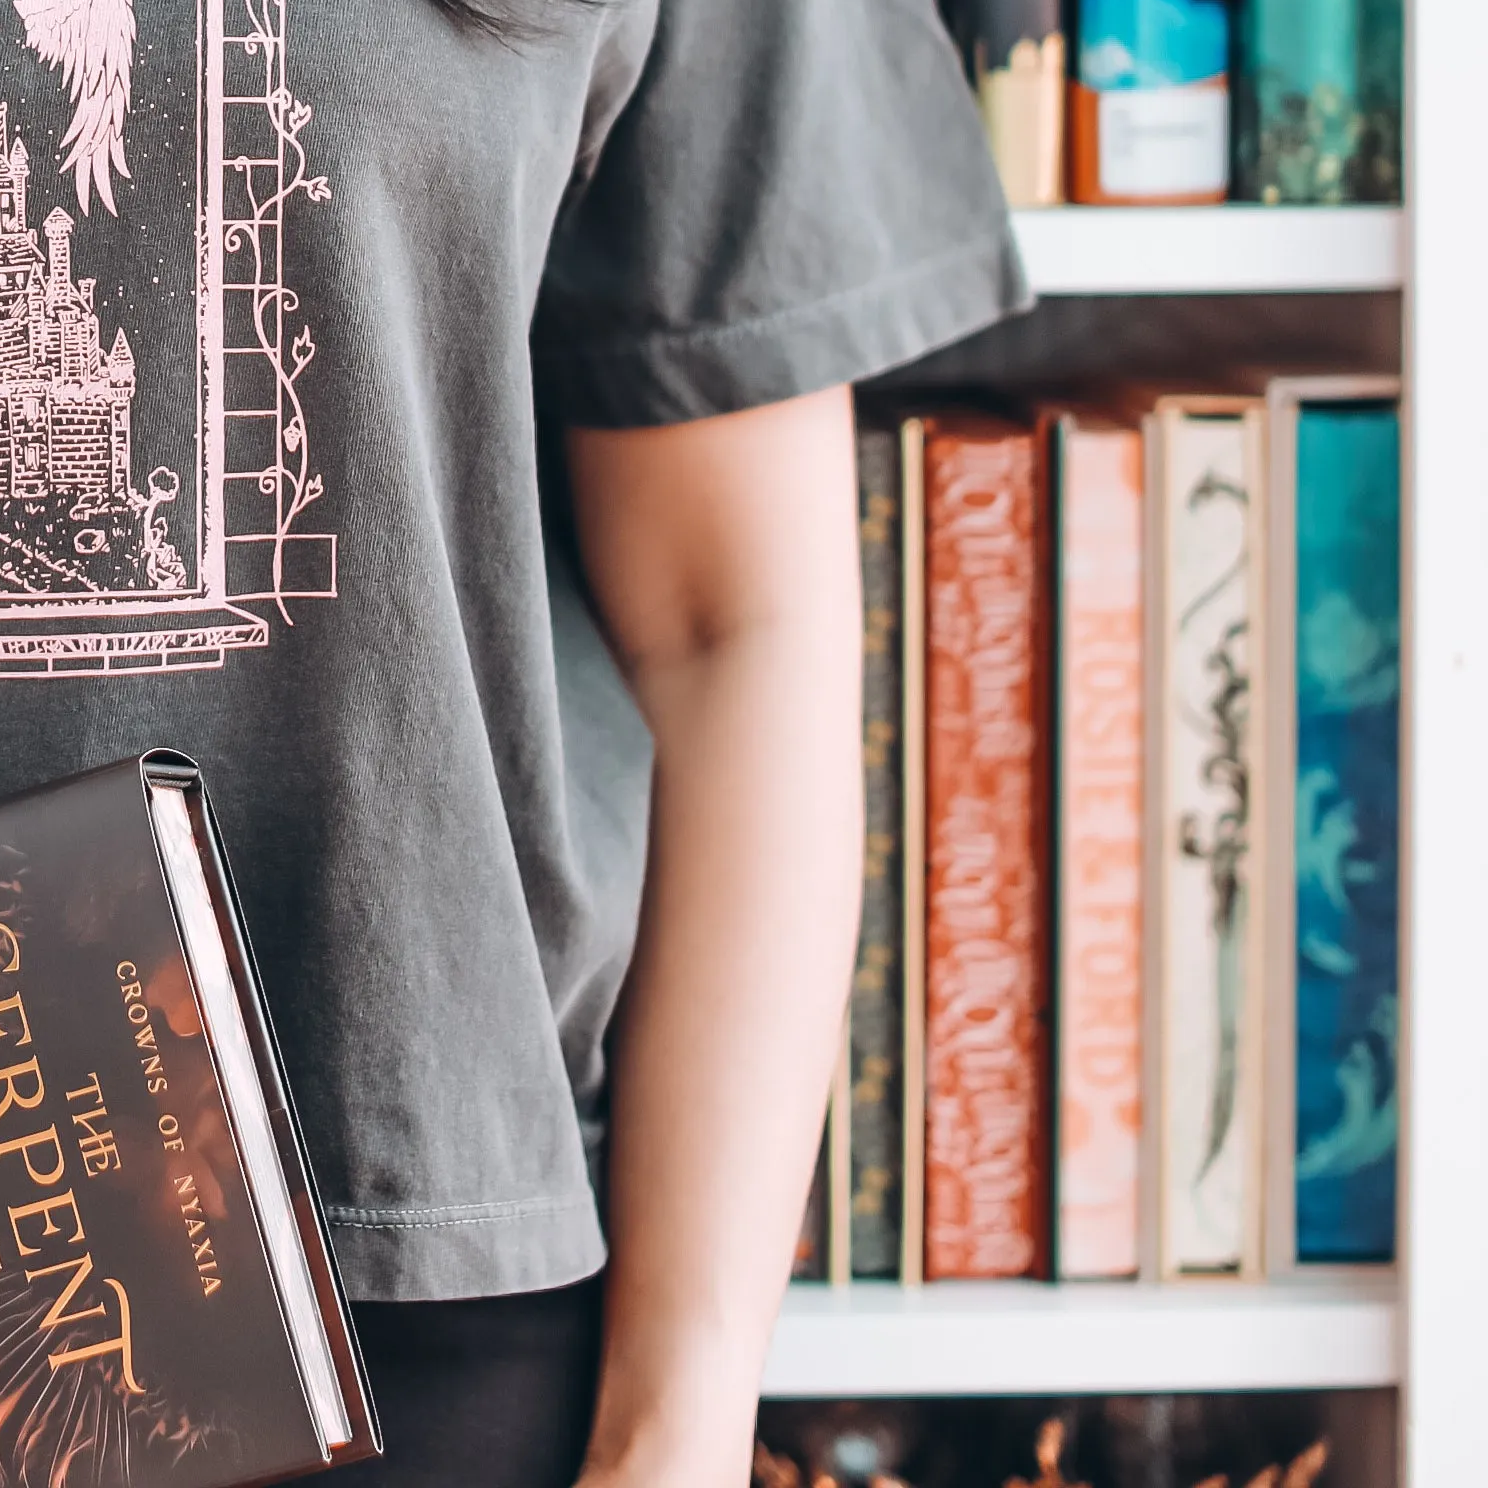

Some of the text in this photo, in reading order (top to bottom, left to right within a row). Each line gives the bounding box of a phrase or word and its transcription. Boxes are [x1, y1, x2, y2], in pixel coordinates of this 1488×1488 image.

[65, 1072, 122, 1178] THE
[116, 960, 222, 1297] CROWNS OF NYAXIA
